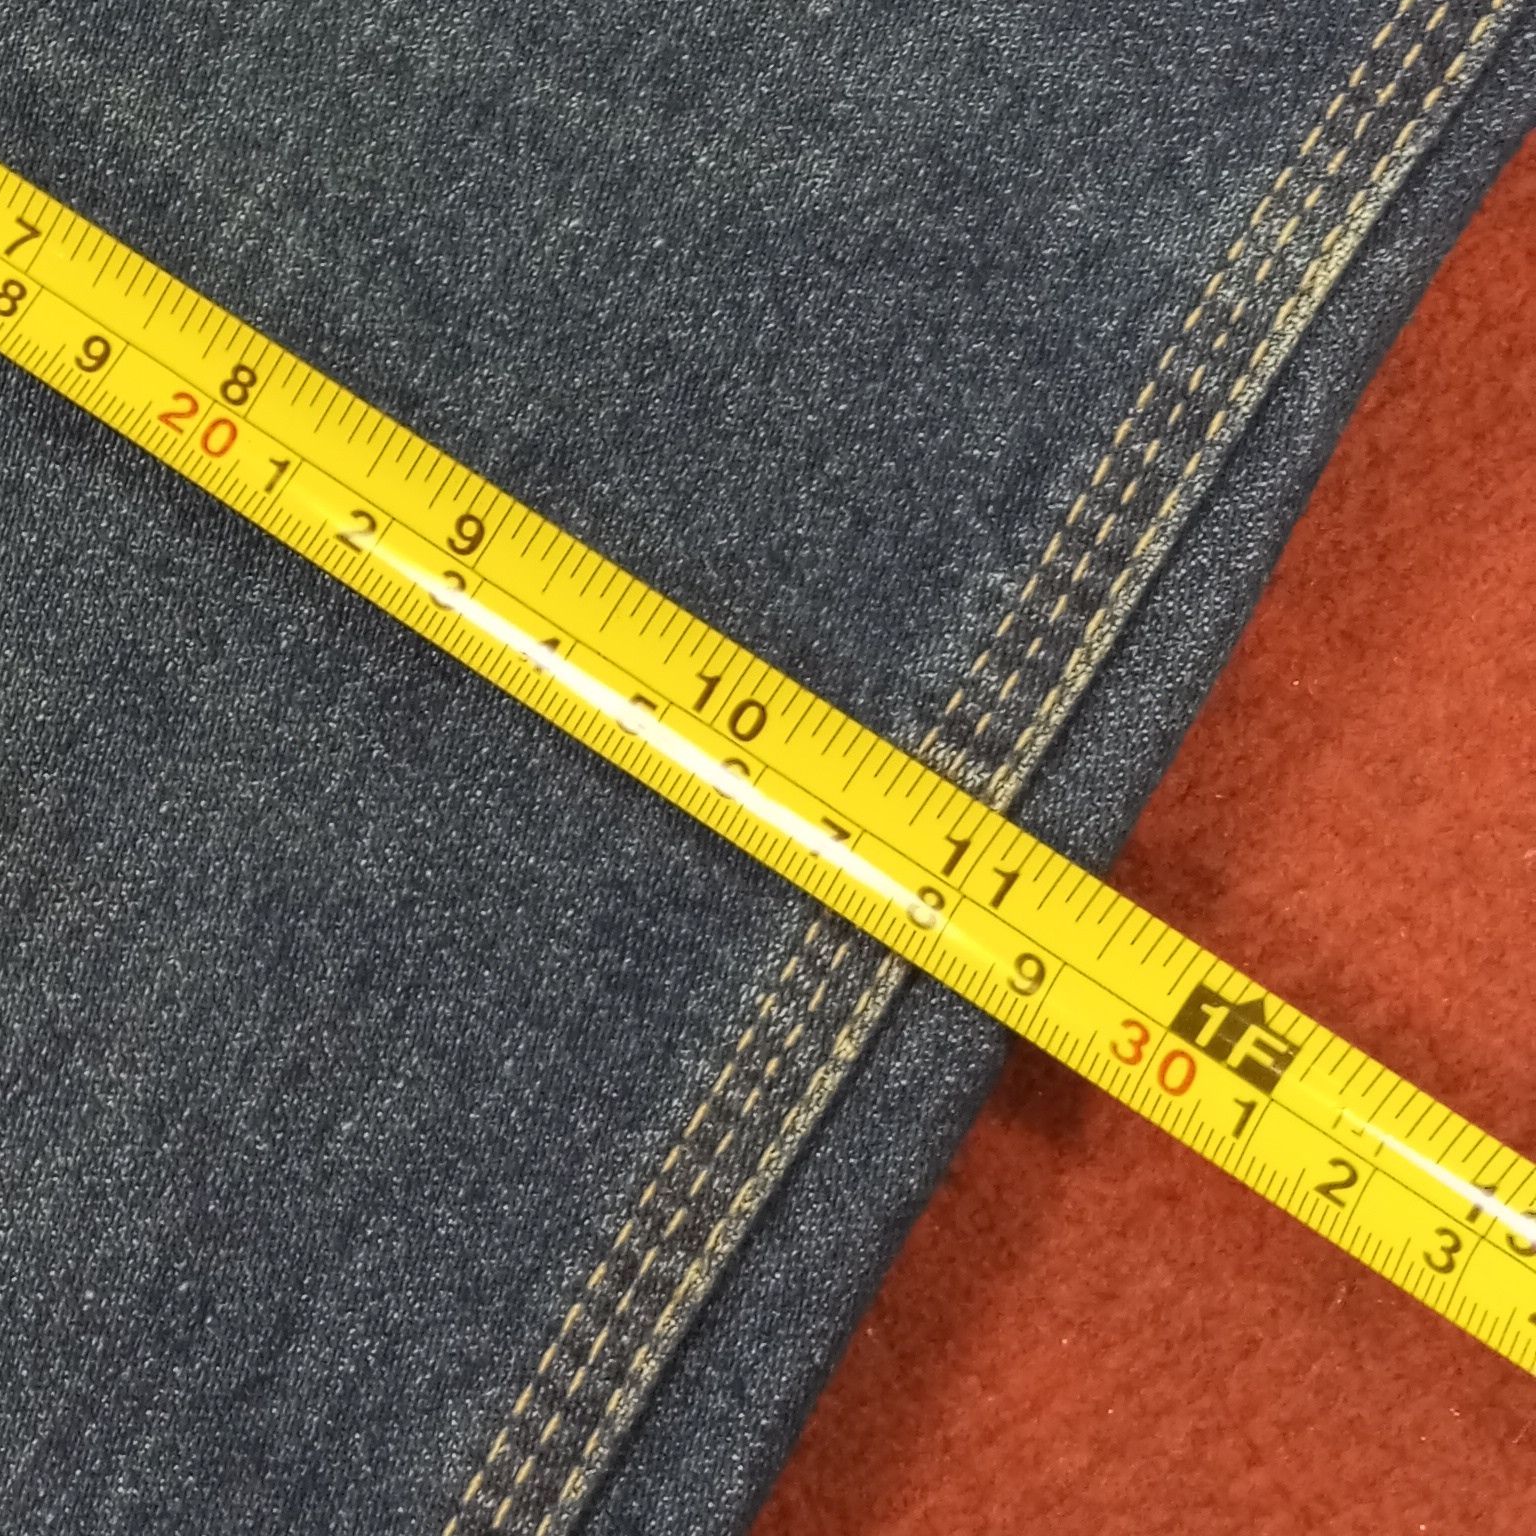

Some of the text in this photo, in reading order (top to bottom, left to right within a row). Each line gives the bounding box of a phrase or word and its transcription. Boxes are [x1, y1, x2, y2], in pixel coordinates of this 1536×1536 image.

[4, 217, 43, 257] 7
[220, 364, 257, 406] 8
[447, 514, 485, 556] 9
[694, 672, 766, 742] 10
[942, 836, 1020, 909] 11
[1194, 1003, 1289, 1068] 1F
[75, 336, 111, 373] 9
[158, 392, 238, 458] 20
[263, 458, 291, 494] 1
[335, 509, 377, 553] 2
[906, 886, 945, 931] 8
[1007, 953, 1047, 996] 9
[1109, 1018, 1197, 1097] 30
[1232, 1096, 1258, 1139] 1
[1314, 1158, 1359, 1208] 2
[1423, 1227, 1463, 1274] 3
